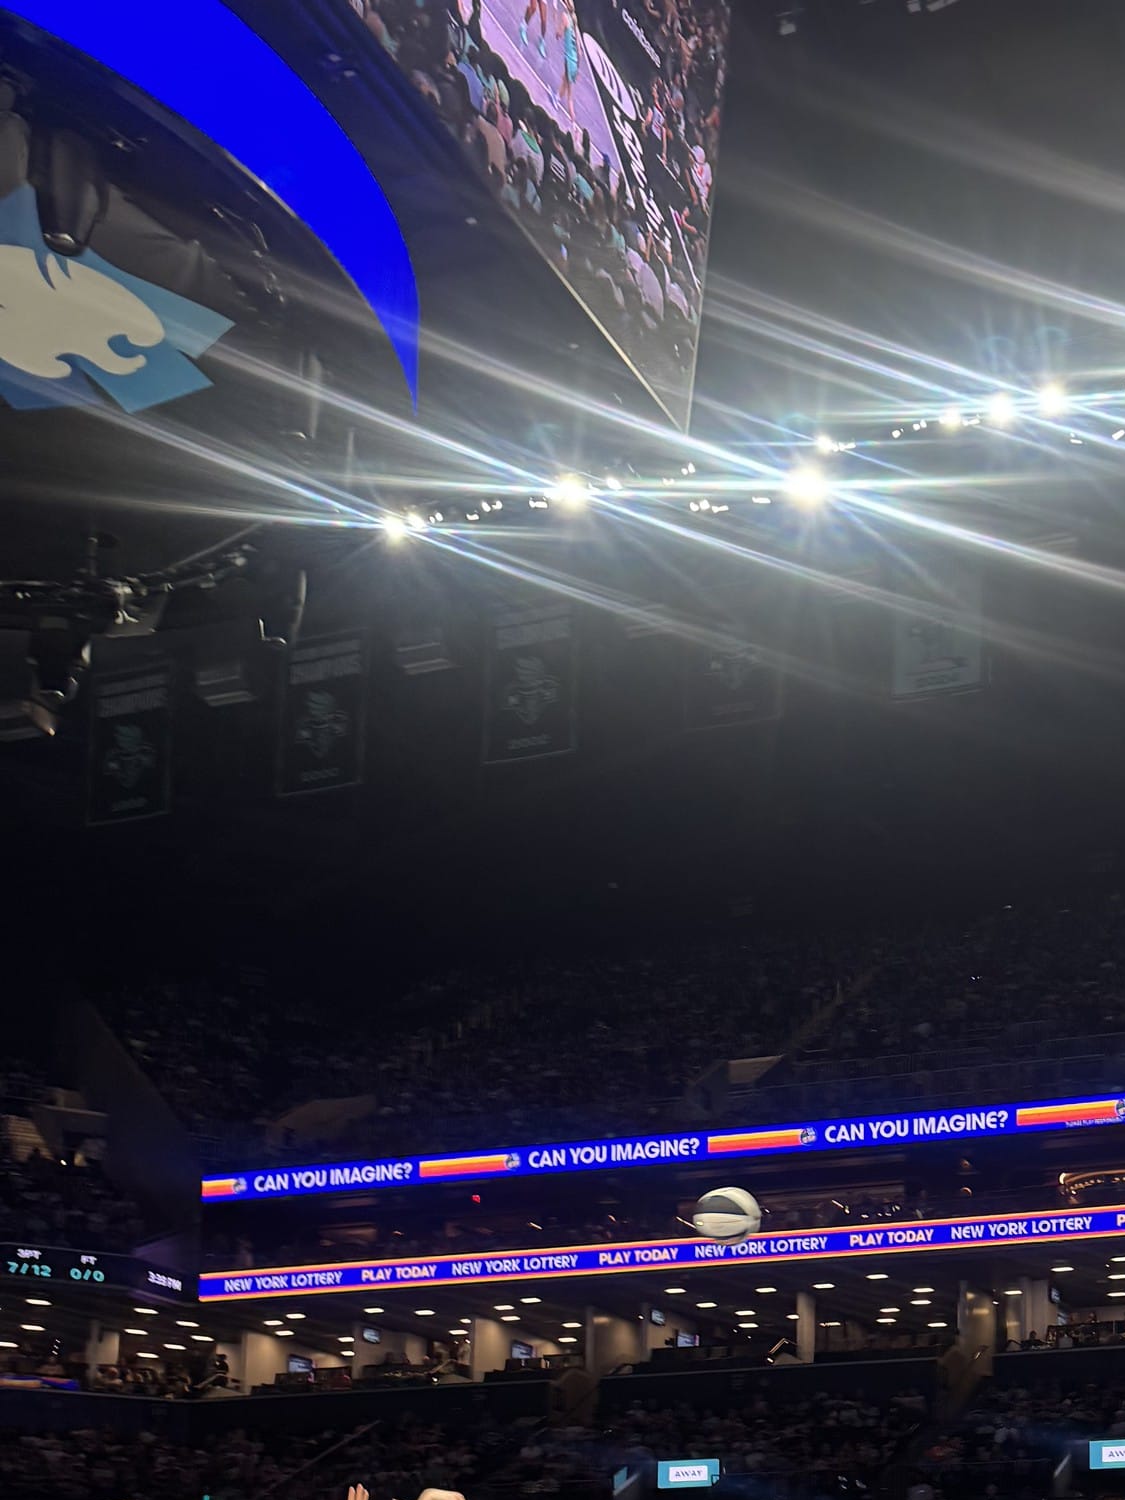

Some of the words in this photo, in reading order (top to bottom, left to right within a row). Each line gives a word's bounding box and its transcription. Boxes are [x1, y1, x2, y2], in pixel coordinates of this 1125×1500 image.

[824, 1123, 864, 1143] CAN
[869, 1119, 909, 1139] YOU
[913, 1110, 1009, 1136] IMAGINE?
[528, 1149, 567, 1169] CAN
[569, 1146, 606, 1165] YOU
[610, 1137, 700, 1161] IMAGINE?
[253, 1174, 289, 1193] CAN
[291, 1170, 326, 1190] YOU
[330, 1161, 413, 1186] IMAGINE?
[849, 1232, 884, 1248] PLAY
[887, 1228, 934, 1244] TODAY
[951, 1224, 985, 1240] NEW
[988, 1221, 1027, 1237] YORK
[1031, 1216, 1092, 1234] LOTTERY
[599, 1251, 631, 1266] PLAY
[634, 1247, 679, 1262] TODAY
[694, 1243, 727, 1258] NEW
[729, 1240, 767, 1256] YORK
[770, 1236, 828, 1252] LOTTERY
[7, 1261, 52, 1278] 7/12
[70, 1268, 105, 1282] 0/0
[361, 1268, 394, 1283] PLAY
[395, 1264, 437, 1279] TODAY
[451, 1261, 483, 1277] NEW
[485, 1258, 521, 1274] YORK
[523, 1254, 578, 1270] LOTTERY
[224, 1278, 252, 1293] NEW
[254, 1275, 289, 1290] YORK
[291, 1271, 343, 1287] LOTTERY
[674, 1469, 704, 1478] AWAY
